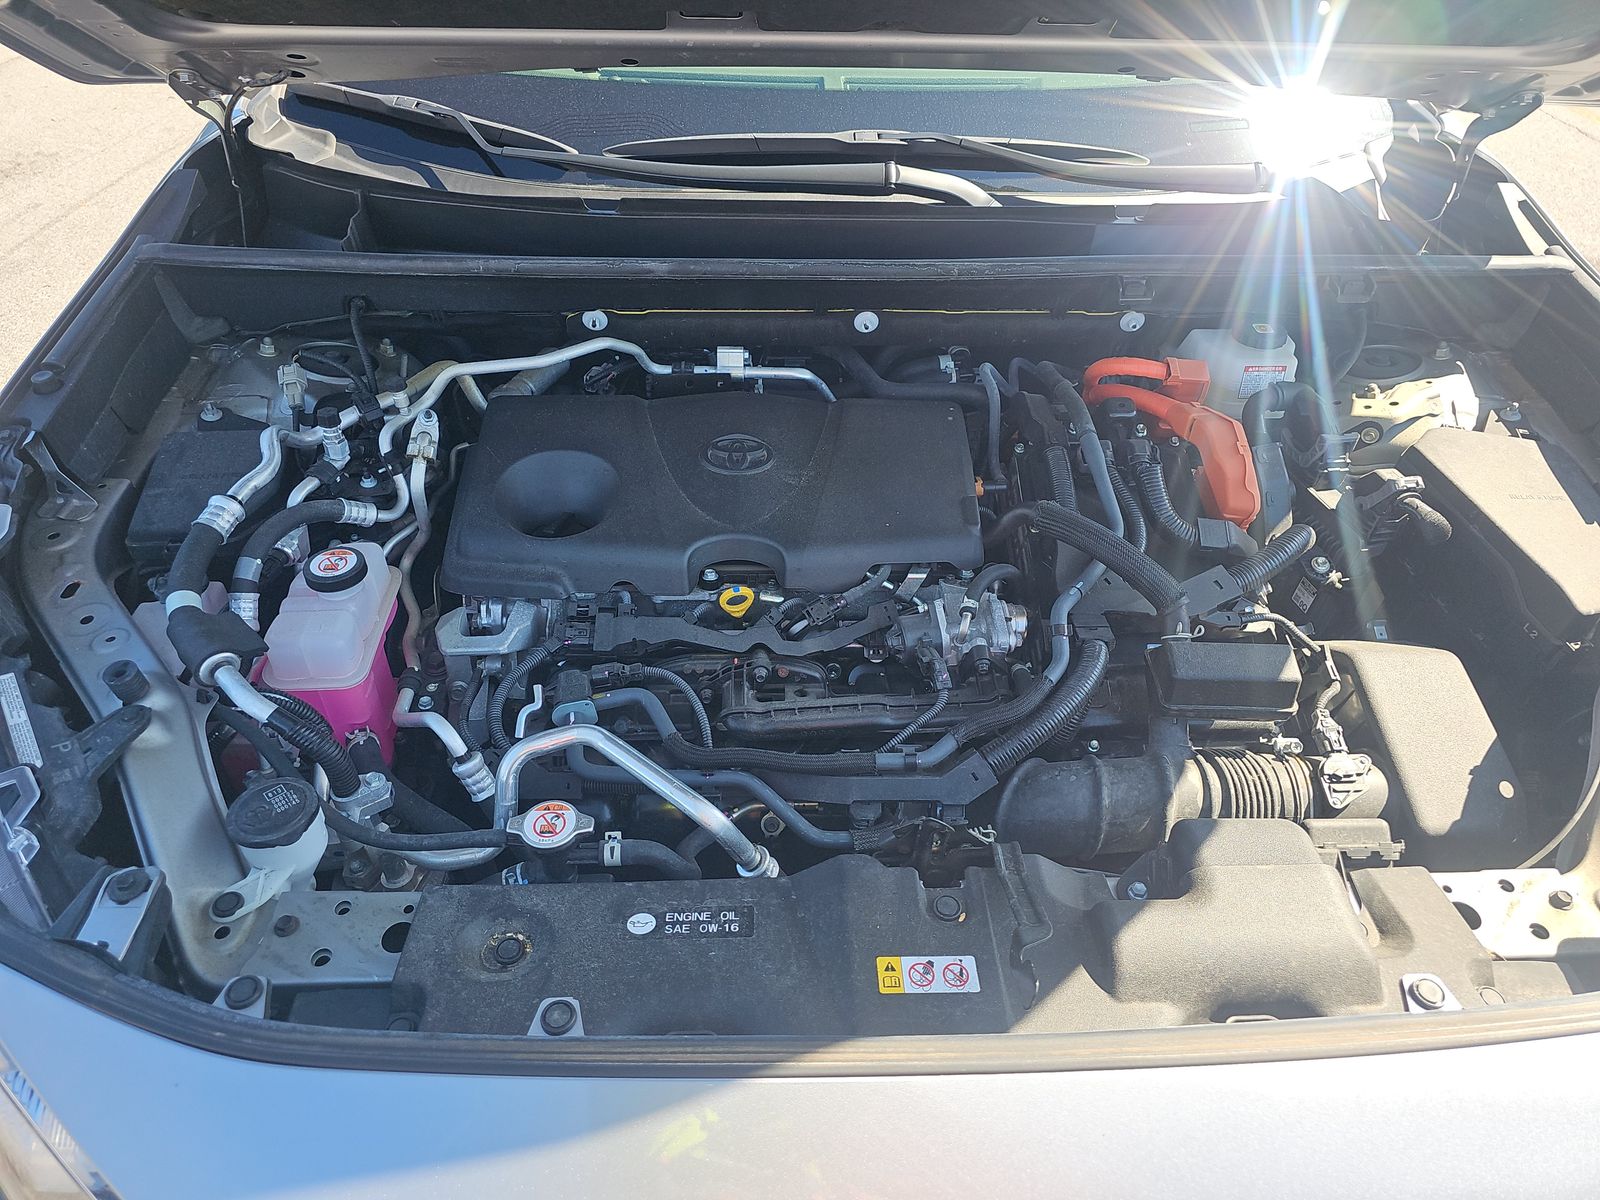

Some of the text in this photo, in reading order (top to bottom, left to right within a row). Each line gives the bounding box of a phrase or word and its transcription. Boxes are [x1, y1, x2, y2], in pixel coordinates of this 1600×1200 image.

[665, 911, 740, 922] ENGINE OIL
[664, 923, 740, 934] SAE 0W-16
